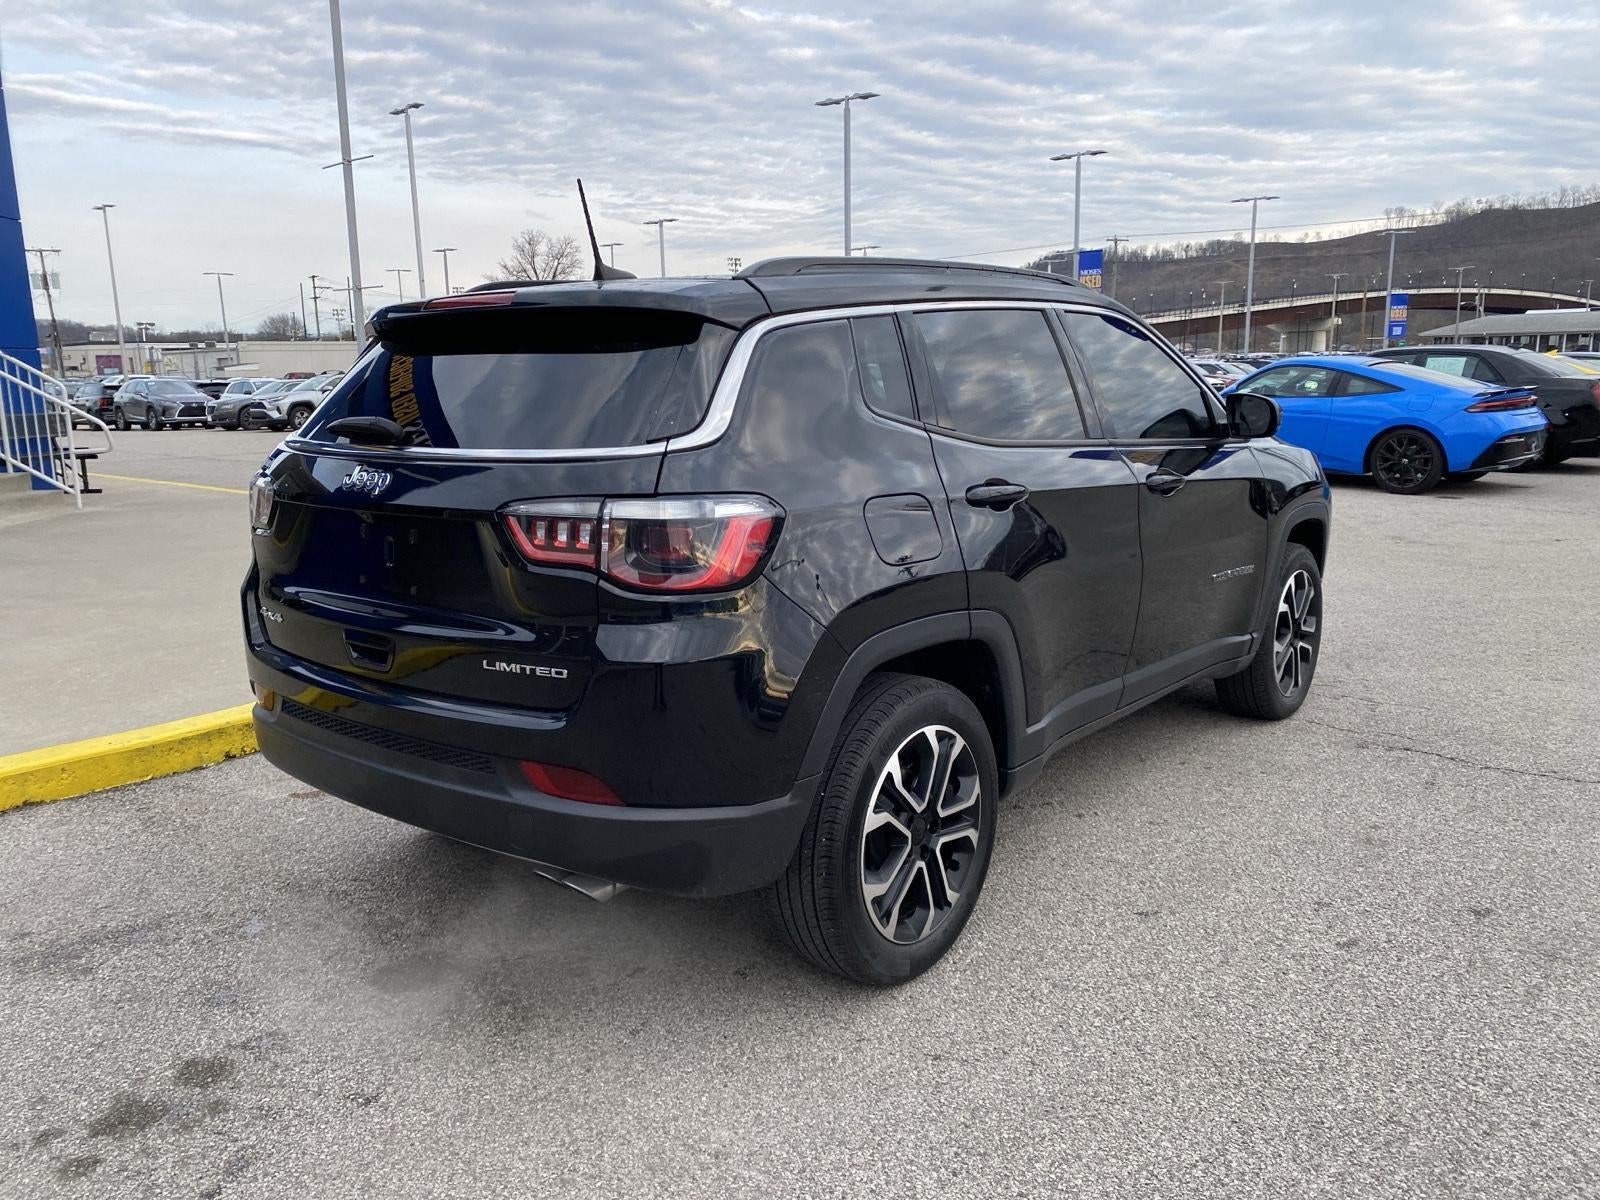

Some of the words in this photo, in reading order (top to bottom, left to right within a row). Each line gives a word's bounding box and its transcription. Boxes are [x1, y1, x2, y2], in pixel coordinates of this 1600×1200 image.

[1080, 275, 1102, 289] USED
[342, 465, 392, 496] Jeep
[482, 659, 568, 679] LIMITED
